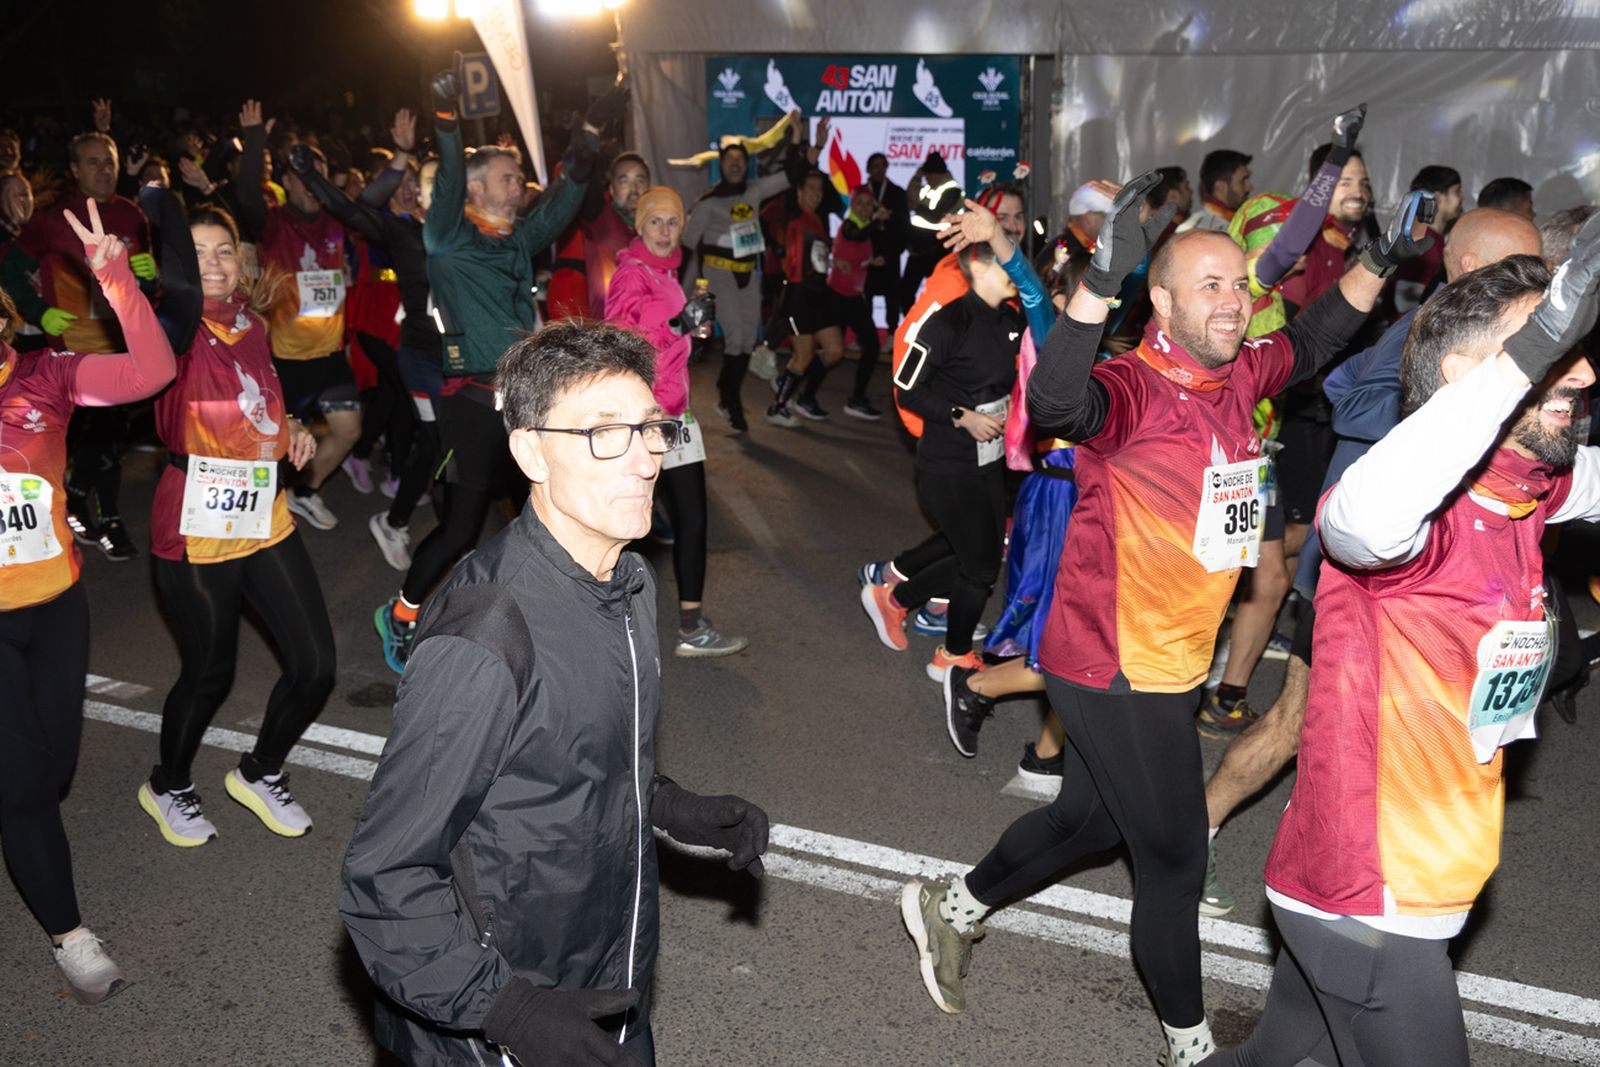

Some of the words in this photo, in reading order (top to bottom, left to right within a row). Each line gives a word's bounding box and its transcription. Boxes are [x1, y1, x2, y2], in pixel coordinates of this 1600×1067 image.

[465, 61, 489, 110] P
[821, 64, 849, 90] 43
[849, 64, 897, 88] SAN
[815, 84, 893, 113] ANTÓN
[886, 144, 922, 160] SAN
[312, 288, 337, 301] 7571
[1223, 474, 1244, 488] NOCHE
[1245, 472, 1253, 484] DE
[206, 487, 259, 512] 3341
[1213, 491, 1229, 504] SAN
[1224, 498, 1260, 535] 396
[1492, 654, 1516, 669] SAN
